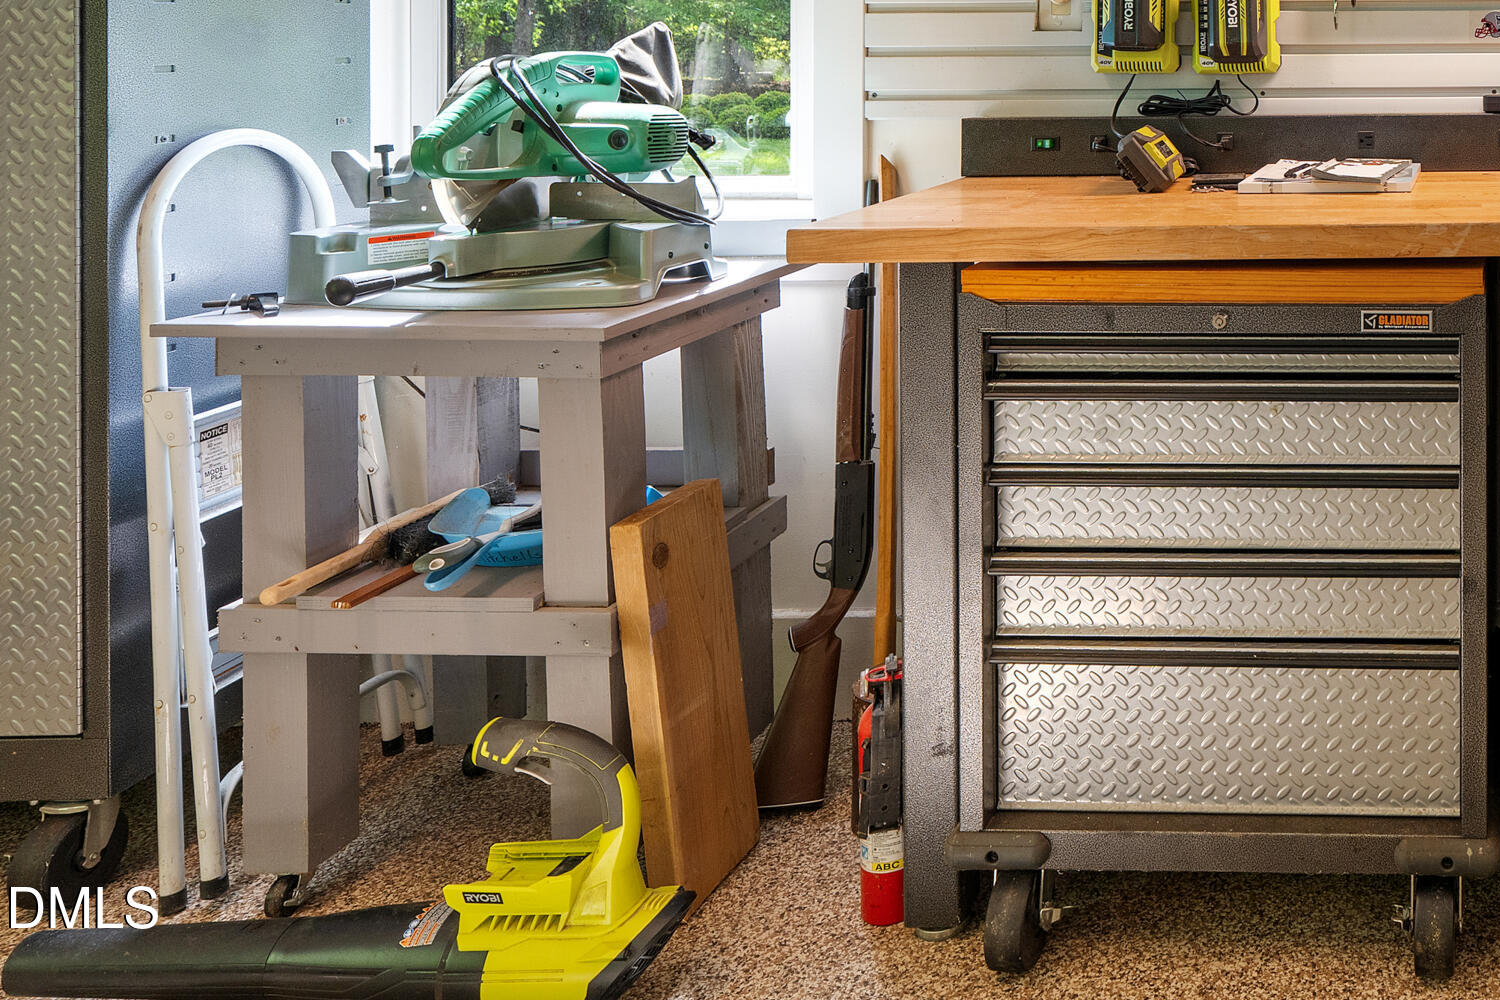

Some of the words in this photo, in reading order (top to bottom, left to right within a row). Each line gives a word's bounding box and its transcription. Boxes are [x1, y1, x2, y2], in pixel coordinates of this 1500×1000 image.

[1124, 0, 1134, 30] RYOBI
[1378, 315, 1429, 326] GLADIATOR
[200, 424, 228, 440] NOTICE
[204, 465, 228, 478] MODEL
[875, 860, 900, 871] ABC
[464, 893, 501, 903] RYOBI
